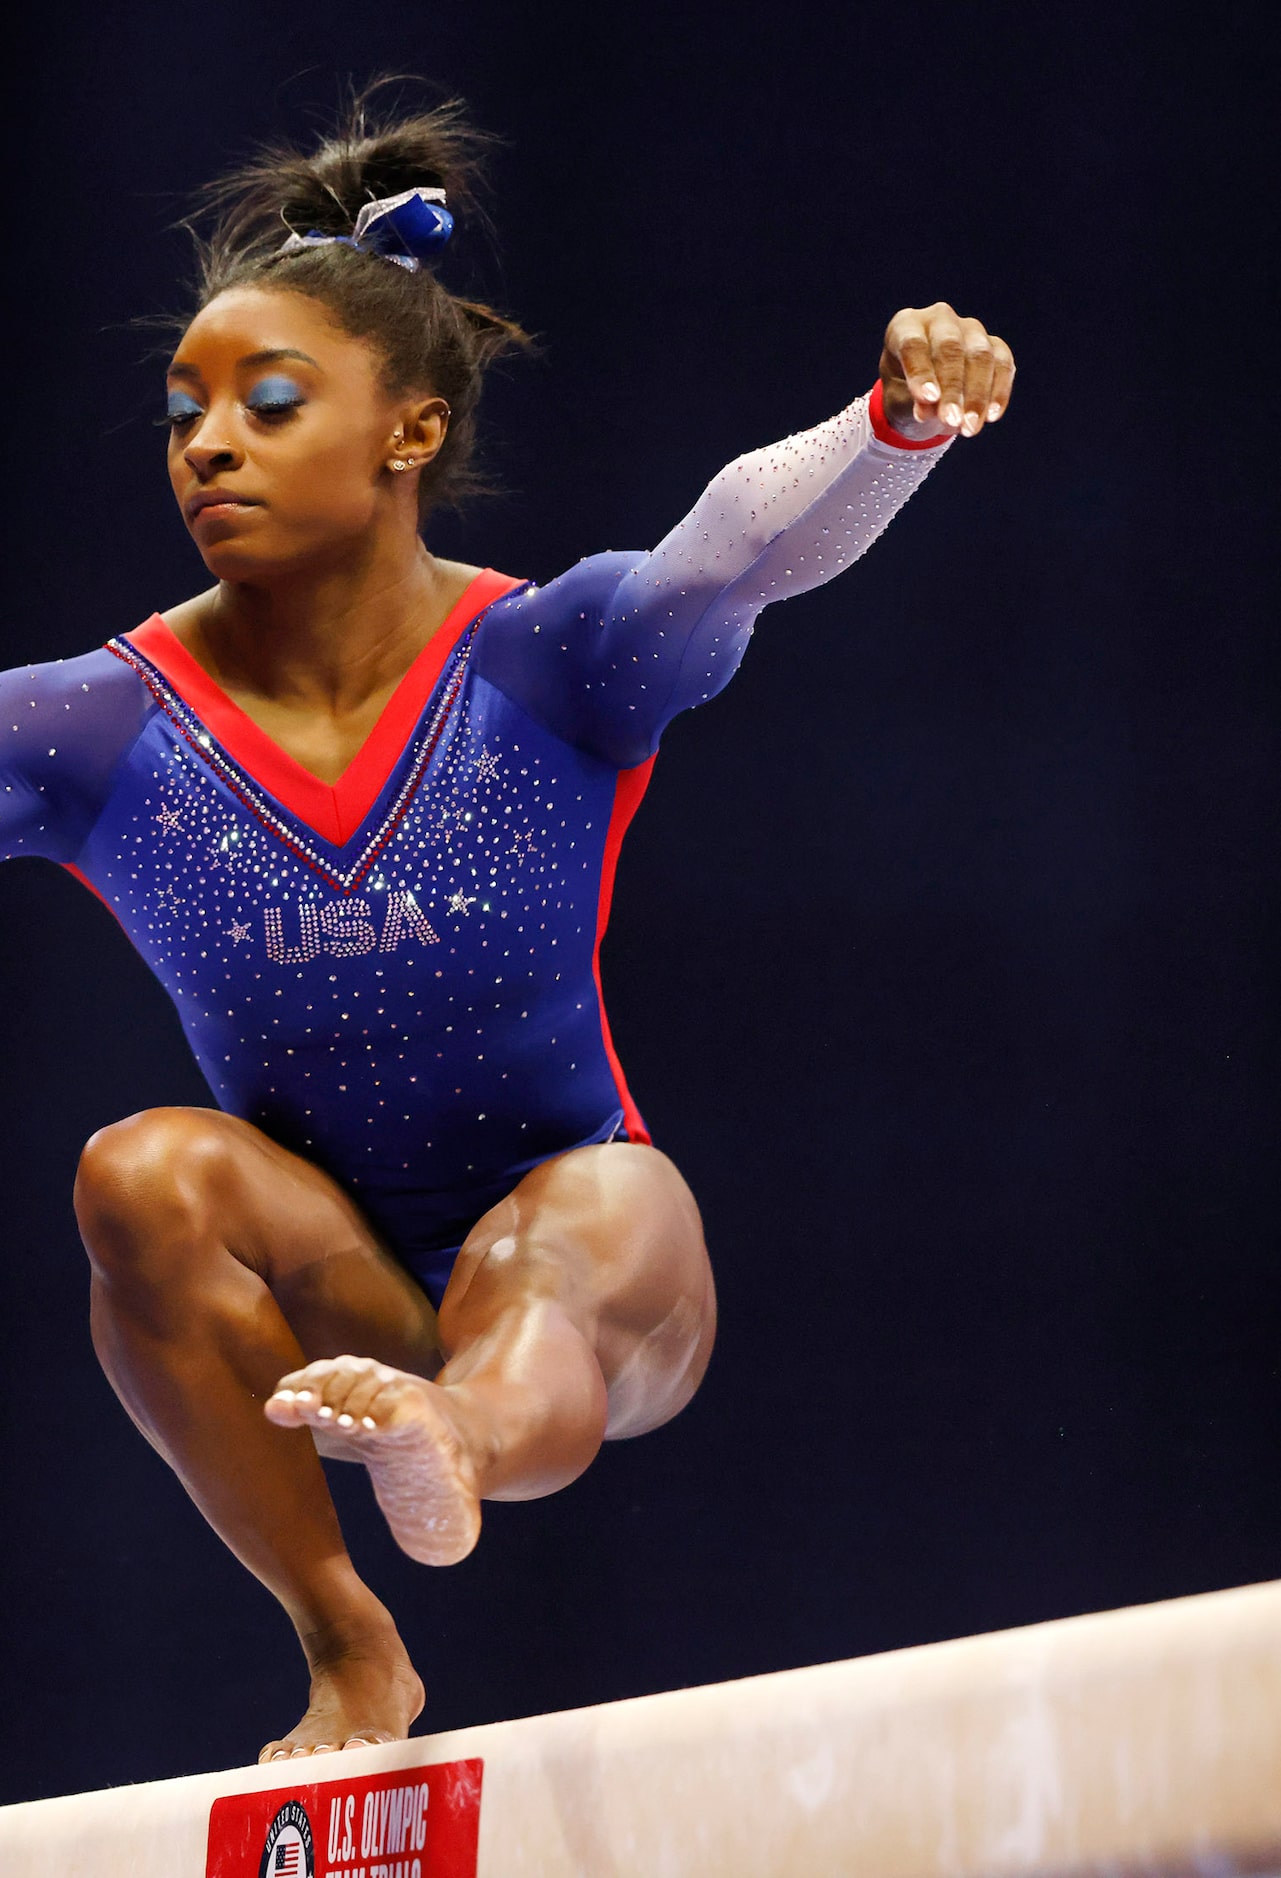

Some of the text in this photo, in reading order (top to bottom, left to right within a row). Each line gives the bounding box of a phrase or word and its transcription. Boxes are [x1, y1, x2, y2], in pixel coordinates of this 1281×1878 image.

[264, 890, 440, 964] USA
[265, 1805, 312, 1853] UNITED STATES
[328, 1782, 429, 1864] U.S. OLYMPIC
